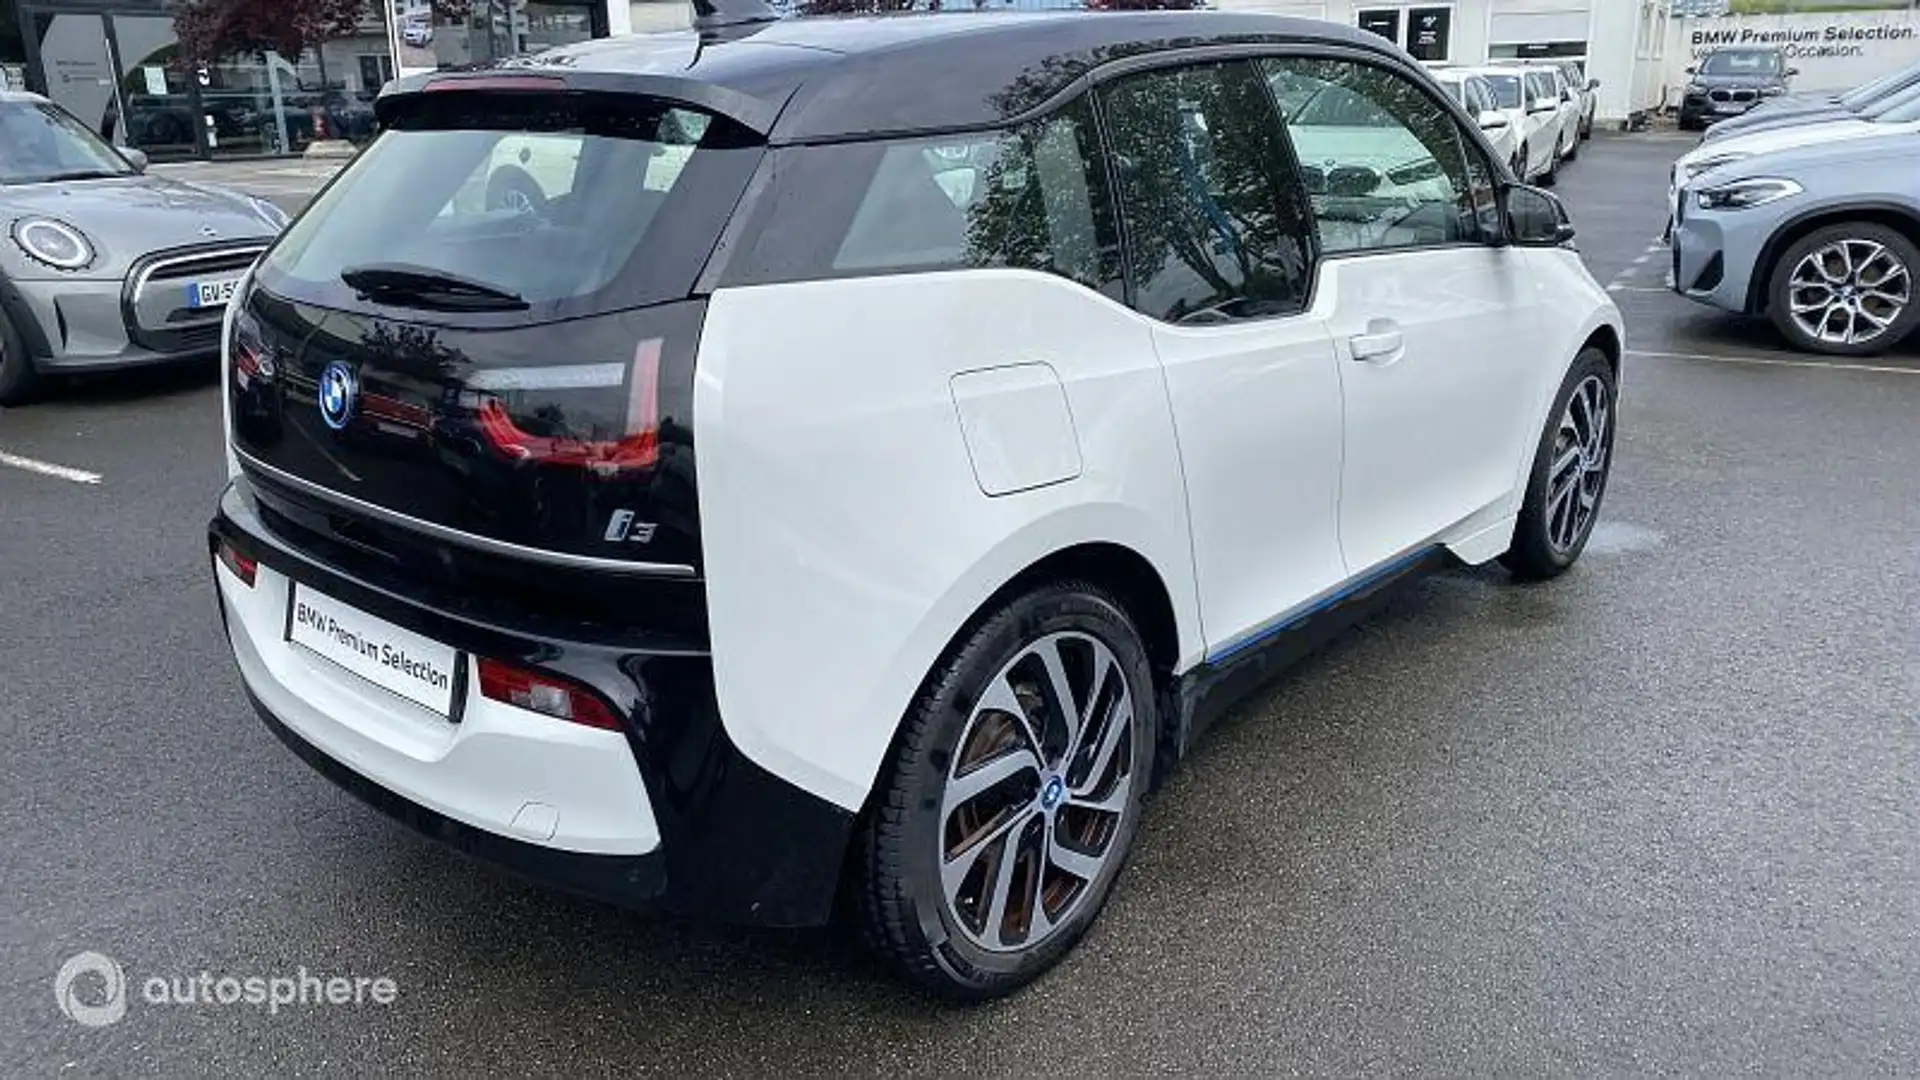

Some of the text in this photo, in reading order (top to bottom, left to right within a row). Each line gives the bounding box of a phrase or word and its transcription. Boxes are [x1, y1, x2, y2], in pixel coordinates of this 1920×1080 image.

[1691, 29, 1737, 45] BMW
[1740, 27, 1818, 43] Premium
[604, 508, 660, 543] i3
[297, 602, 449, 690] BMW Premium Selection
